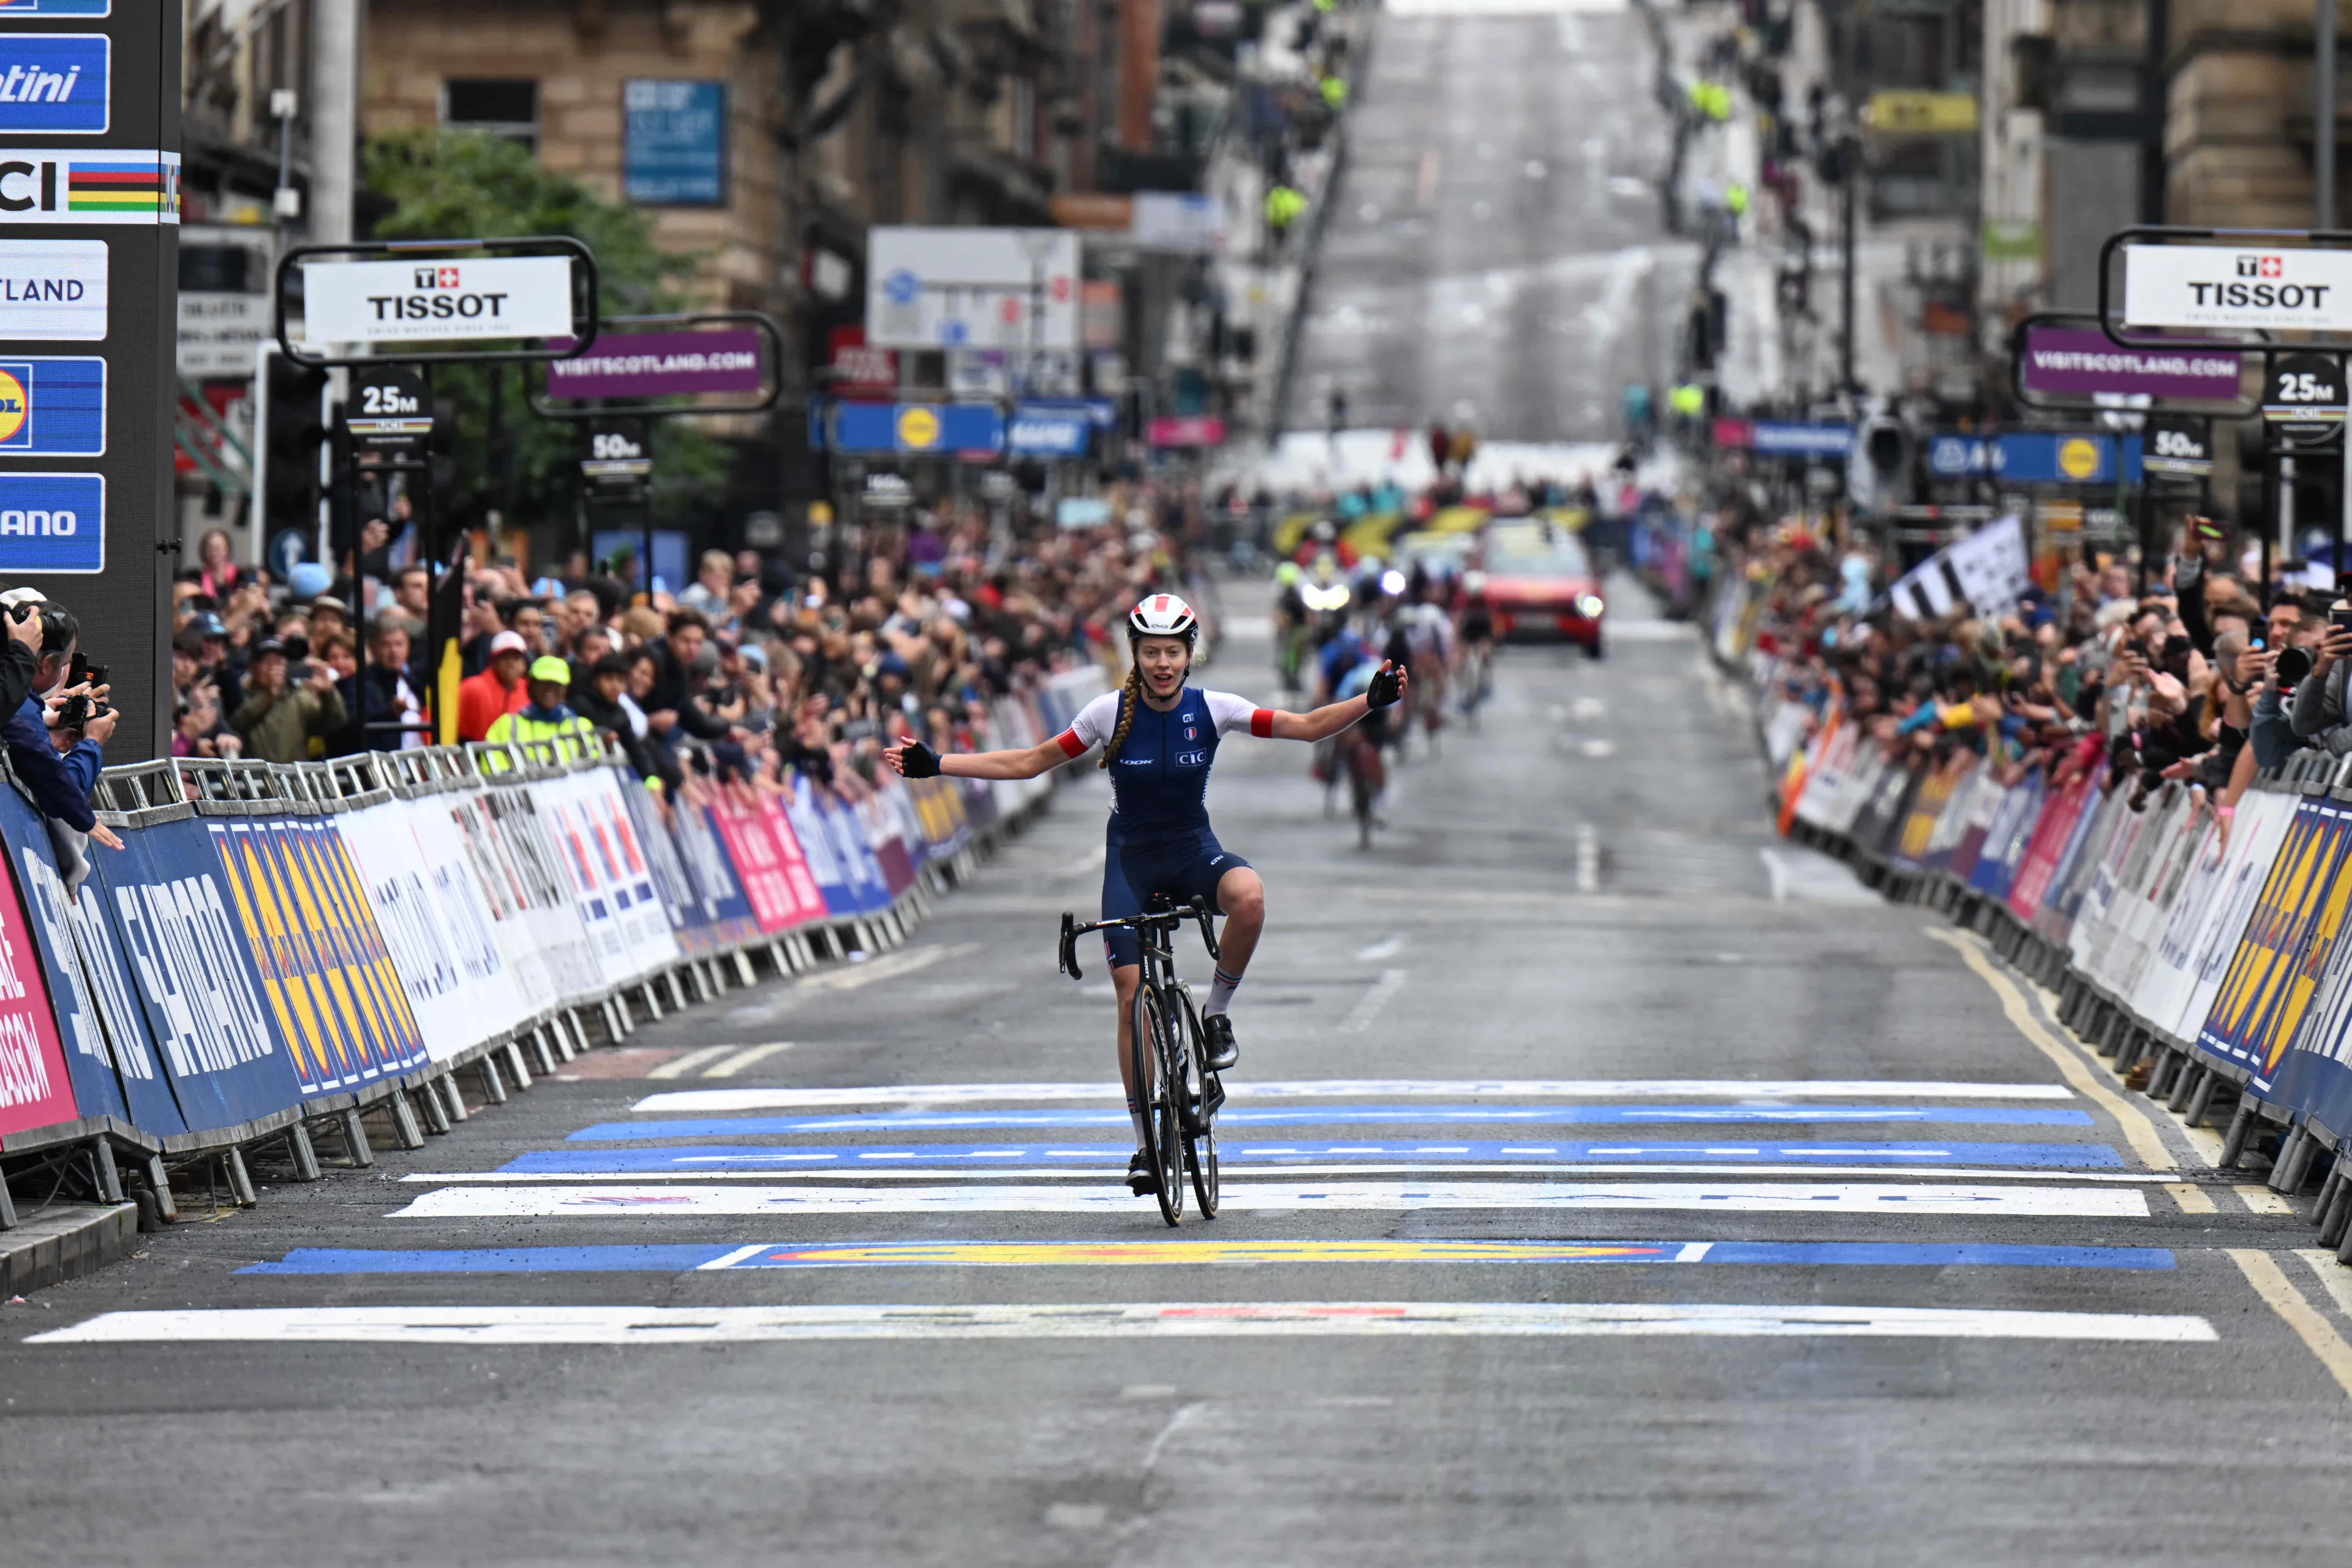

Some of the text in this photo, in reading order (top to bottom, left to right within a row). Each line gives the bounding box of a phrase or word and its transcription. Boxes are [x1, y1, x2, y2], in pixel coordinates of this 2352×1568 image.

[0, 279, 83, 301] LAND
[2187, 282, 2329, 309] TISSOT
[367, 293, 508, 320] TISSOT
[552, 350, 756, 377] VISITSCOTLAND.COM
[2033, 350, 2237, 377] VISITSCOTLAND.COM
[1179, 752, 1204, 764] CIC
[115, 873, 273, 1077] SHIMANO
